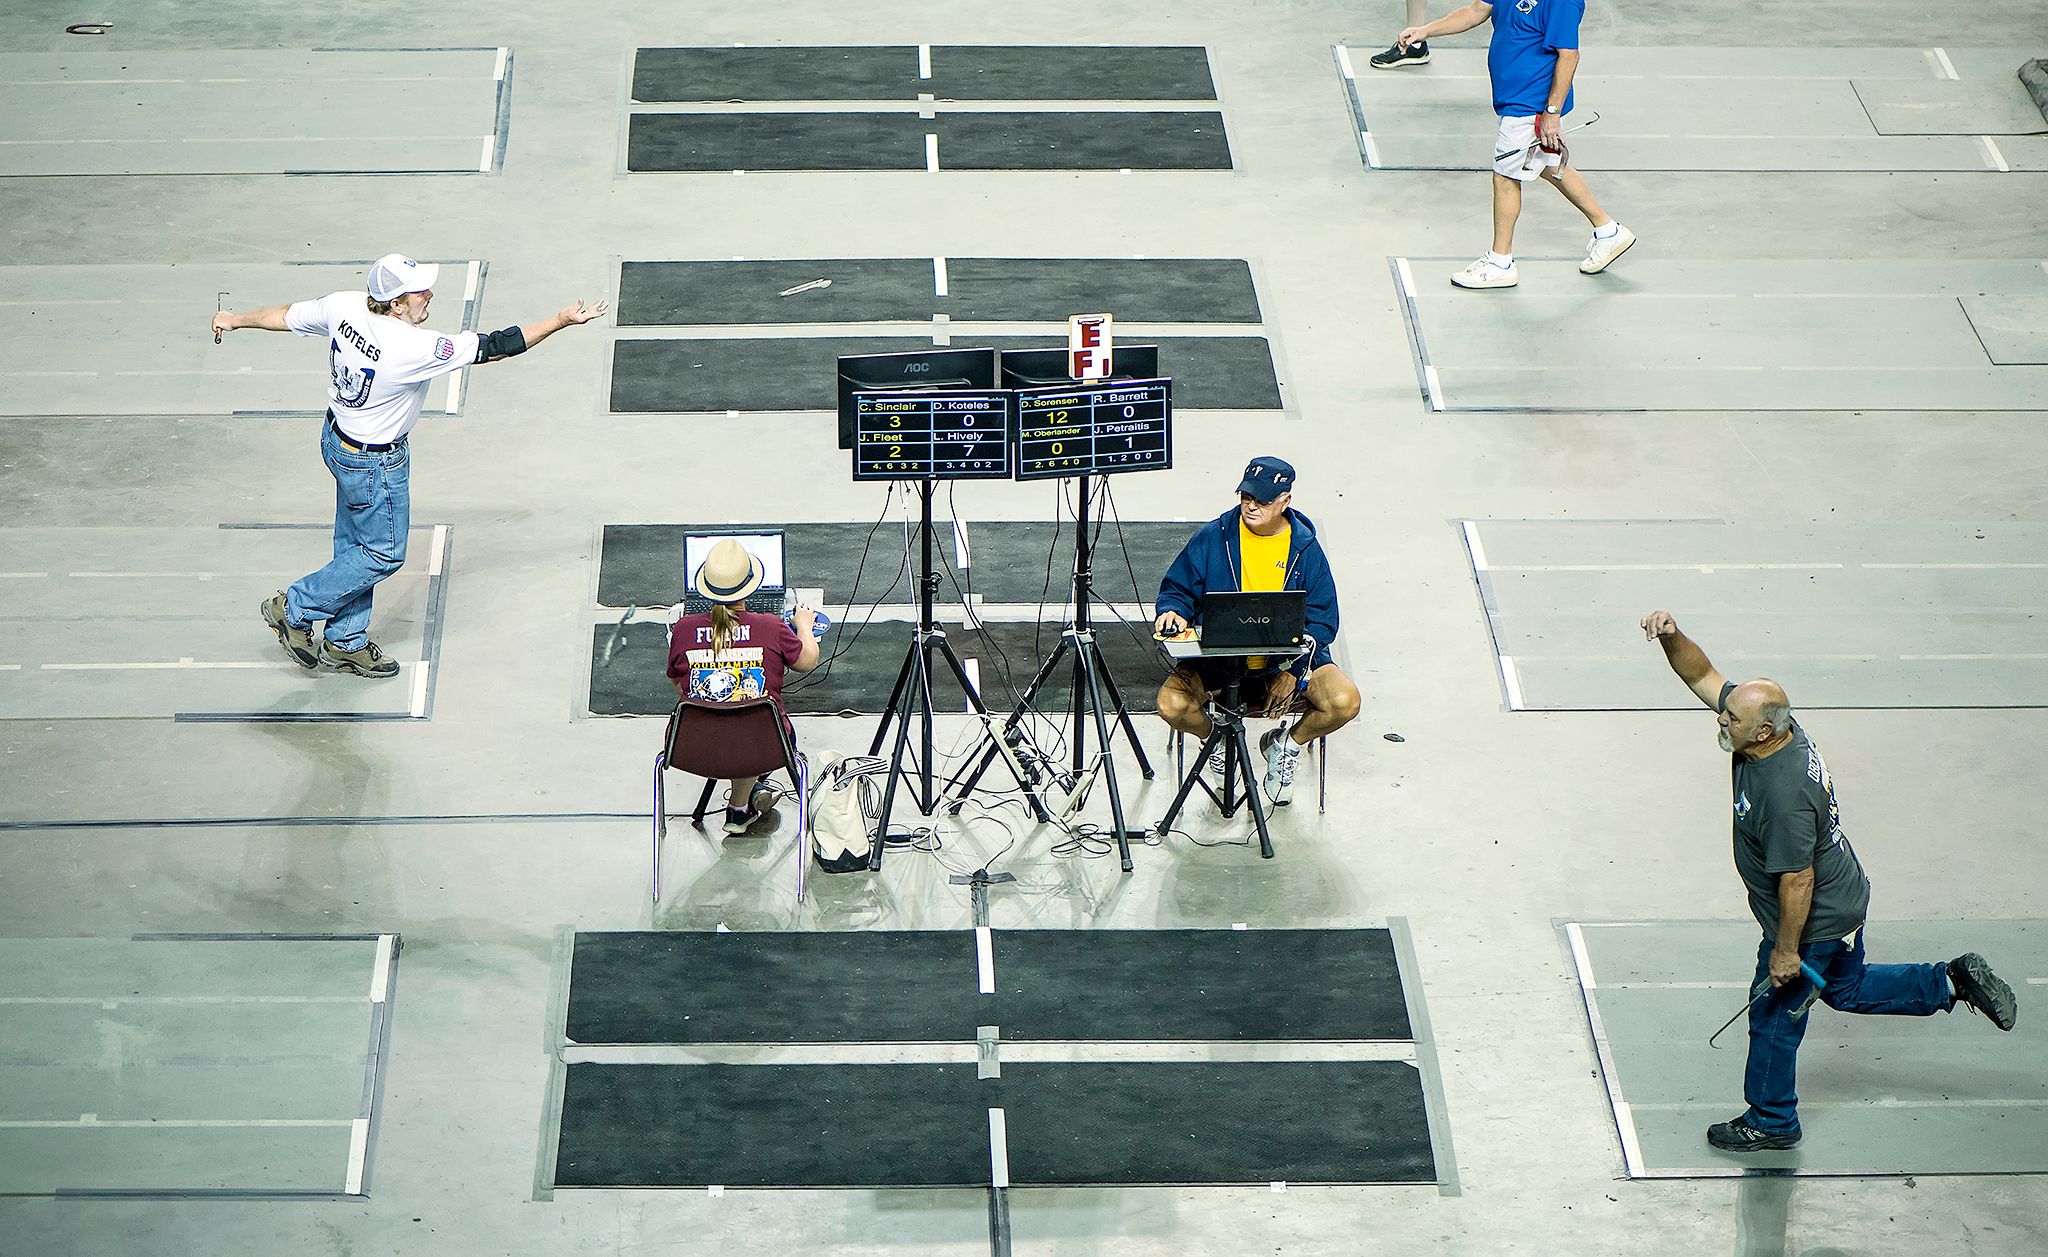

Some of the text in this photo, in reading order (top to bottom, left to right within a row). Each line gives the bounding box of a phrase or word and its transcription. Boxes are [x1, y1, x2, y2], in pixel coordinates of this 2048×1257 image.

[337, 319, 381, 362] KOTELES
[1082, 322, 1100, 348] E
[904, 362, 930, 373] AOC
[1074, 350, 1092, 378] F
[1021, 397, 1079, 408] D. Sorensen
[1094, 391, 1149, 404] R. Barrett
[859, 402, 917, 411] C. Sinclair
[933, 401, 990, 410] D. Koteles
[1123, 405, 1135, 418] 0
[889, 415, 901, 428] 3
[963, 414, 975, 427] 0
[1046, 411, 1069, 425] 12
[1021, 427, 1081, 438] M. Oberlander
[1094, 422, 1150, 434] J. Petraitis
[859, 433, 903, 442] J. Fleet
[933, 431, 984, 443] L. Hively
[1124, 436, 1133, 449] 1
[889, 445, 901, 458] 2
[963, 444, 975, 457] 7
[1051, 442, 1063, 455] 0
[1237, 616, 1270, 624] VAIO
[688, 660, 763, 670] TOURNAMENT
